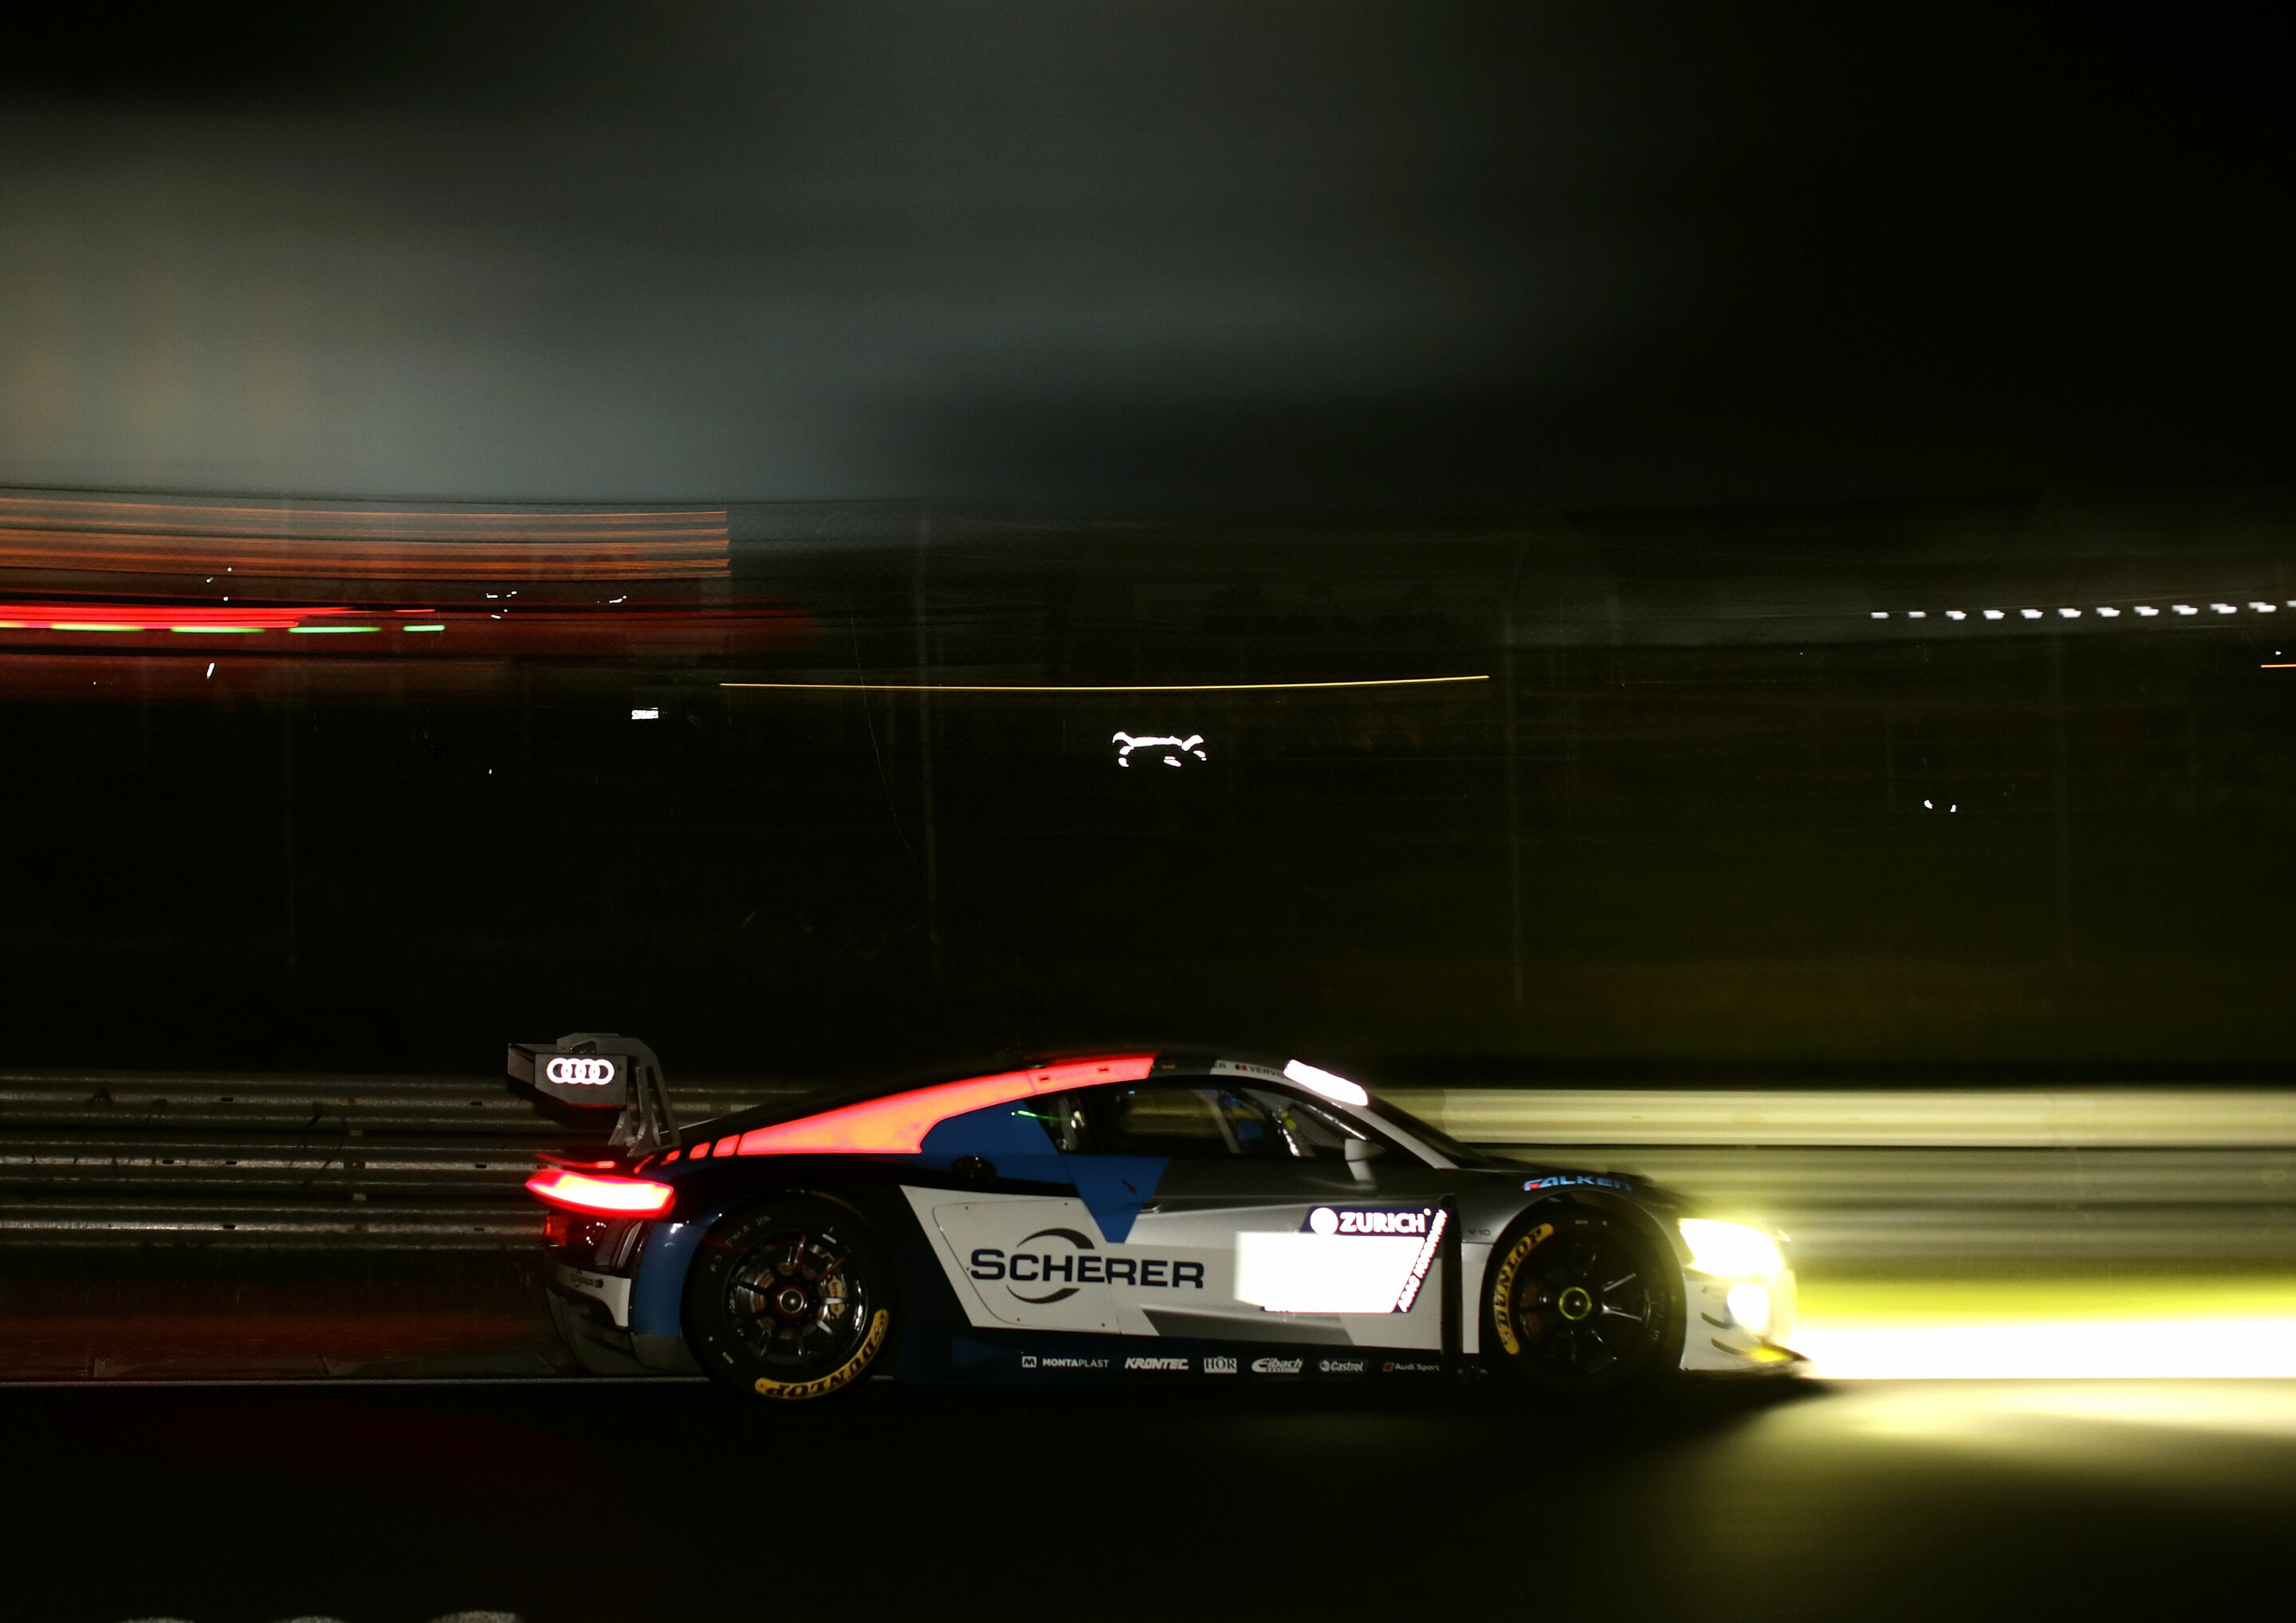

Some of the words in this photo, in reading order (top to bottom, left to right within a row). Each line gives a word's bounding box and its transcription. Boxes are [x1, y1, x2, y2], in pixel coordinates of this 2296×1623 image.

[1523, 1175, 1633, 1191] FALKEN
[1339, 1212, 1425, 1233] ZURICH
[970, 1248, 1205, 1289] SCHERER
[1496, 1228, 1543, 1326] DUNLOP
[766, 1336, 876, 1398] DUNLOP
[1042, 1358, 1110, 1369] MONTAPLAST
[1124, 1357, 1189, 1370] KRONTEC
[1205, 1357, 1236, 1370] HÖR
[1331, 1360, 1364, 1372] Castrol
[1395, 1362, 1416, 1372] Audi
[1417, 1363, 1441, 1373] Sport
